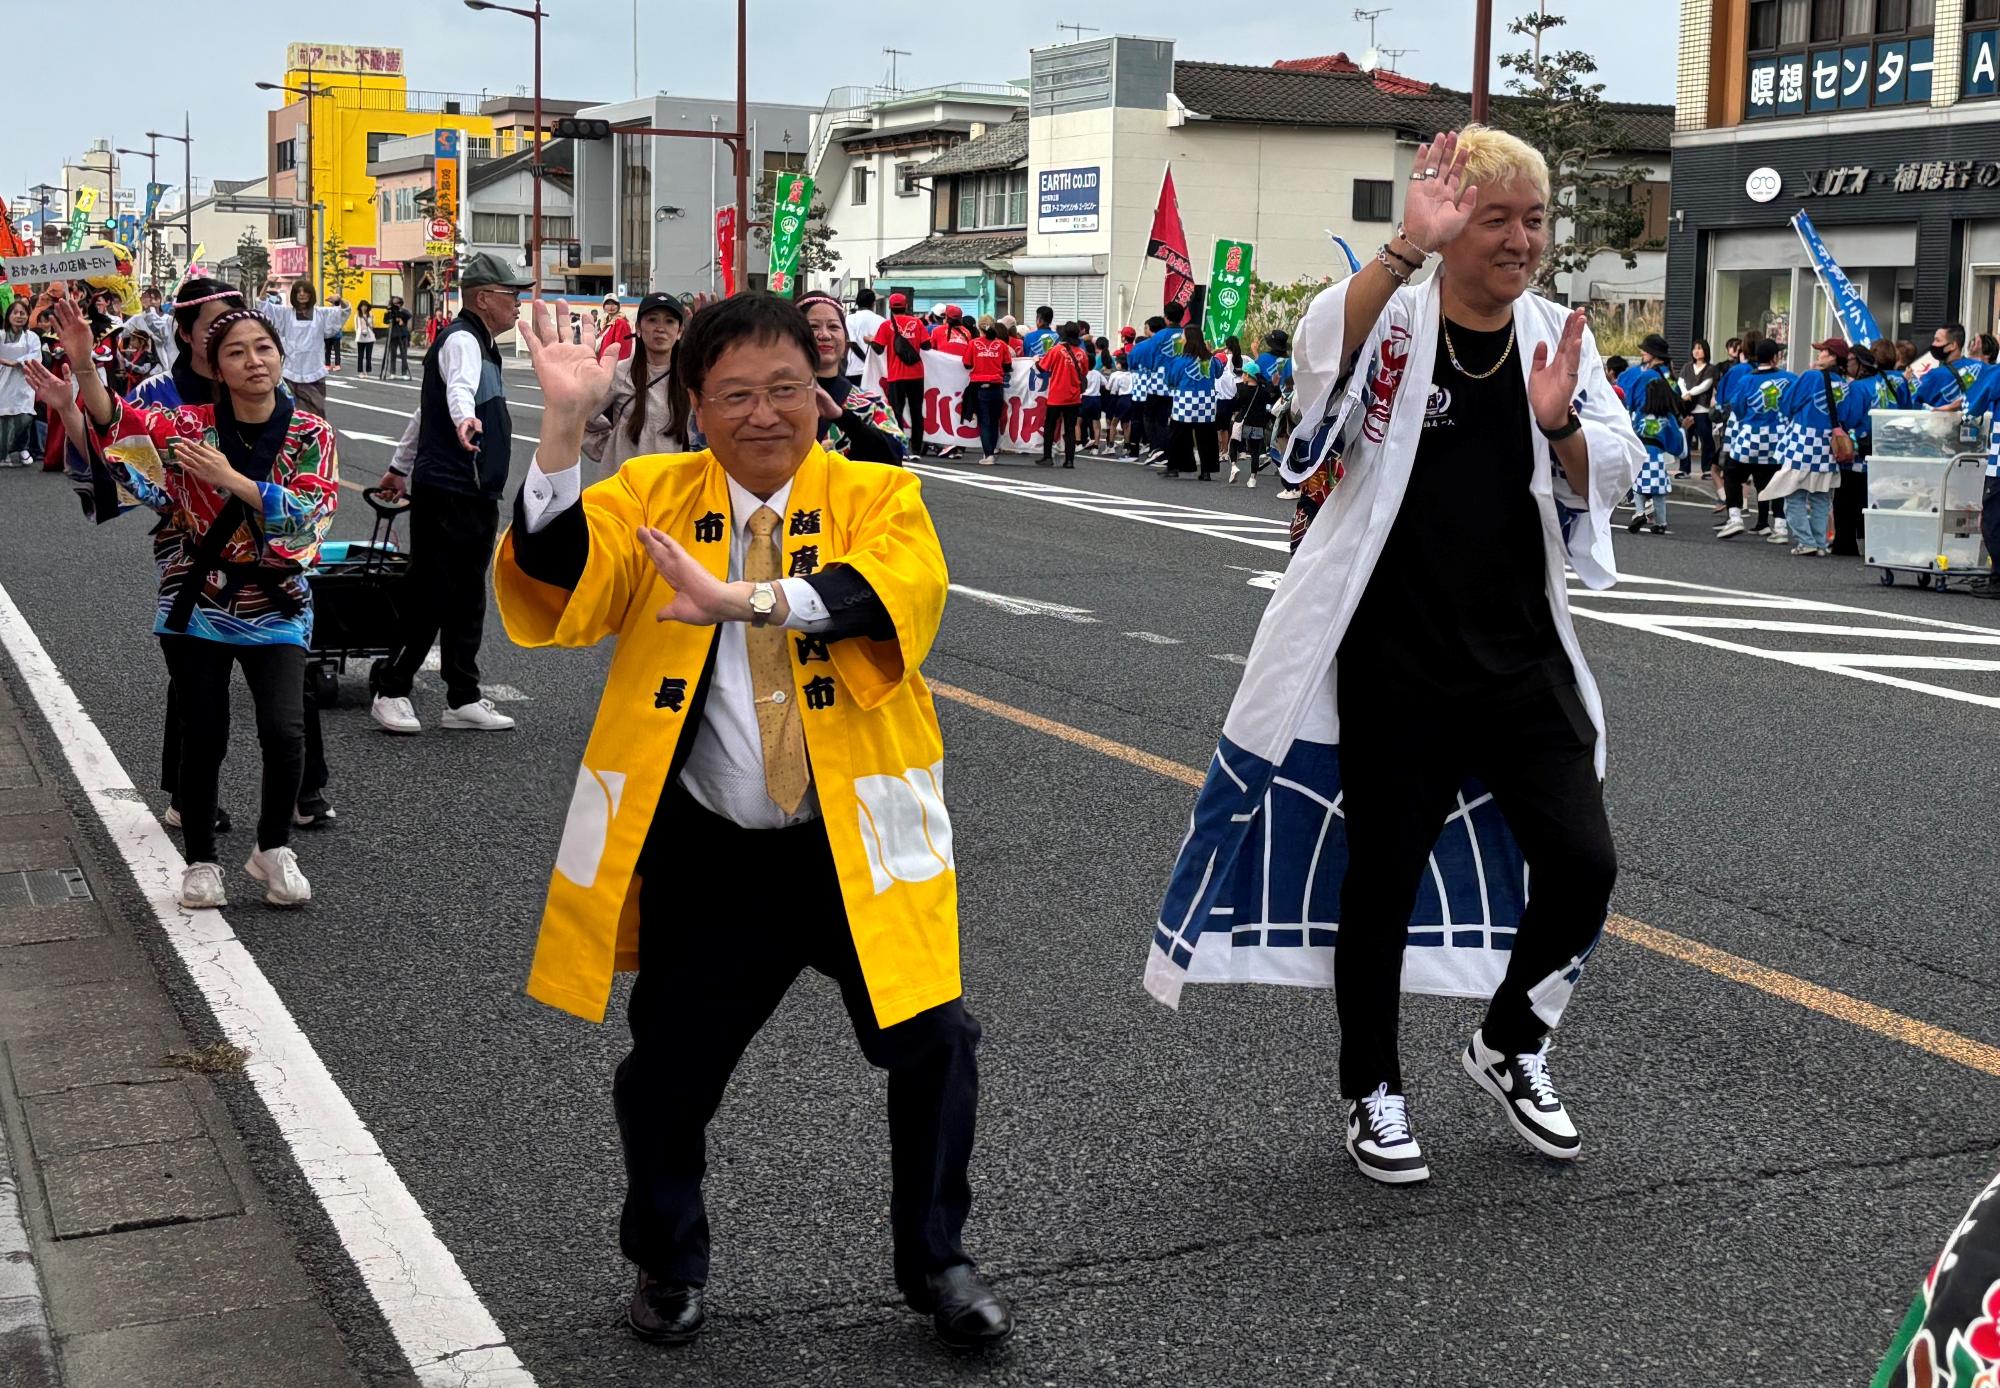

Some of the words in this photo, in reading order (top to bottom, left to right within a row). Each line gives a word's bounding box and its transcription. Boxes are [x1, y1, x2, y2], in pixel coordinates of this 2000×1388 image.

[1751, 51, 1934, 106] 瞑想センター
[1041, 173, 1071, 191] EARTH
